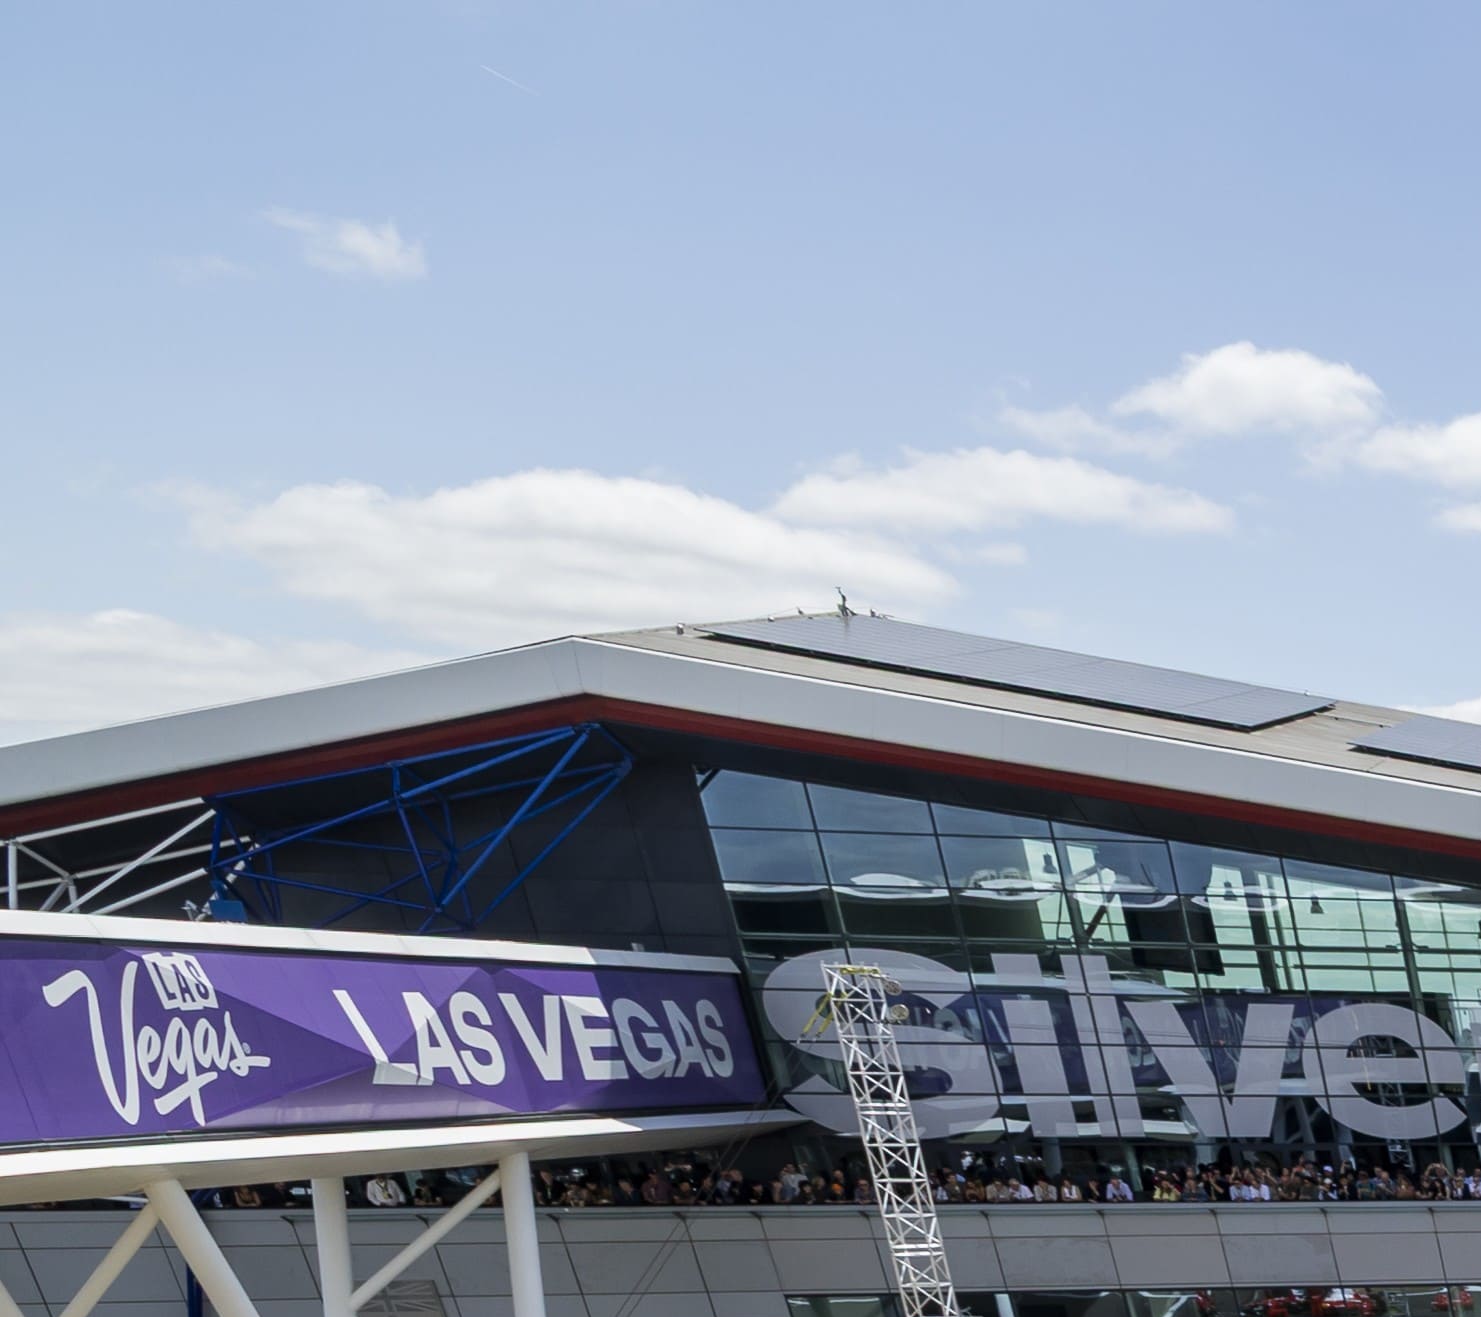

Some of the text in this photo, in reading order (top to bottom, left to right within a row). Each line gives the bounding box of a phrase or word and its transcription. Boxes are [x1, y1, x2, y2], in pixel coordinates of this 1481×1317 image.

[153, 954, 213, 1006] LAS
[42, 961, 271, 1126] Vegas
[332, 988, 735, 1087] LAS VEGAS
